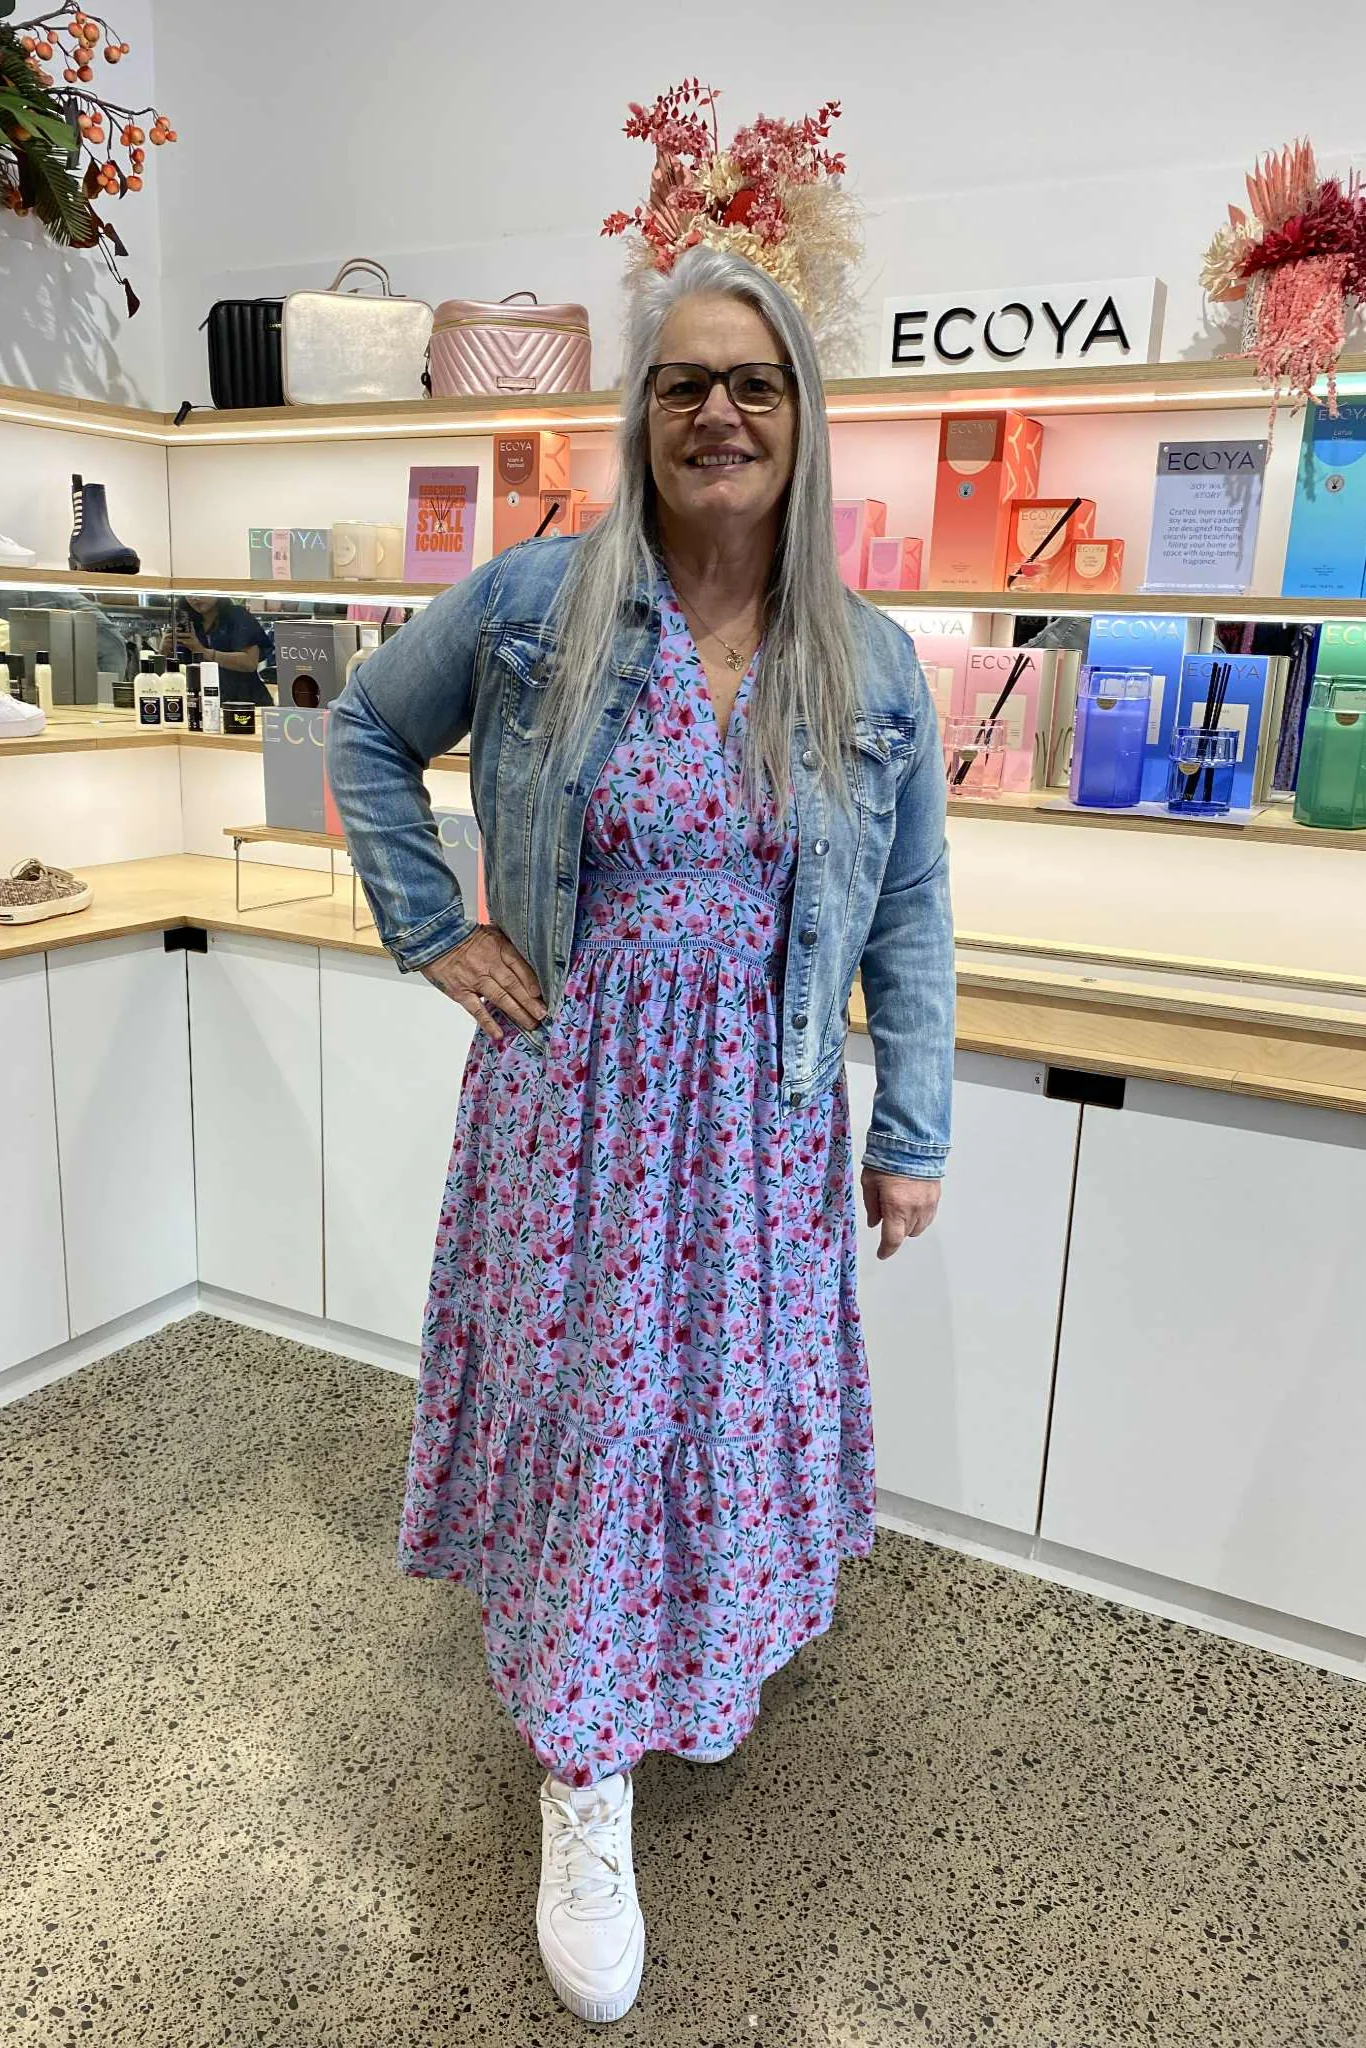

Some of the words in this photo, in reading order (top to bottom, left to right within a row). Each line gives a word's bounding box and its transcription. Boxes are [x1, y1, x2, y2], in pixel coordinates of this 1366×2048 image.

[892, 296, 1131, 364] ECOYA
[500, 442, 532, 452] ECOYA
[1167, 451, 1255, 471] ECOYA
[1169, 507, 1197, 516] Crafted
[1217, 507, 1243, 515] natural
[1180, 524, 1213, 533] designed
[250, 530, 326, 550] ECYA
[1095, 619, 1180, 640] ECOYA
[280, 646, 328, 661] ECOYA
[1187, 662, 1260, 680] ECYA
